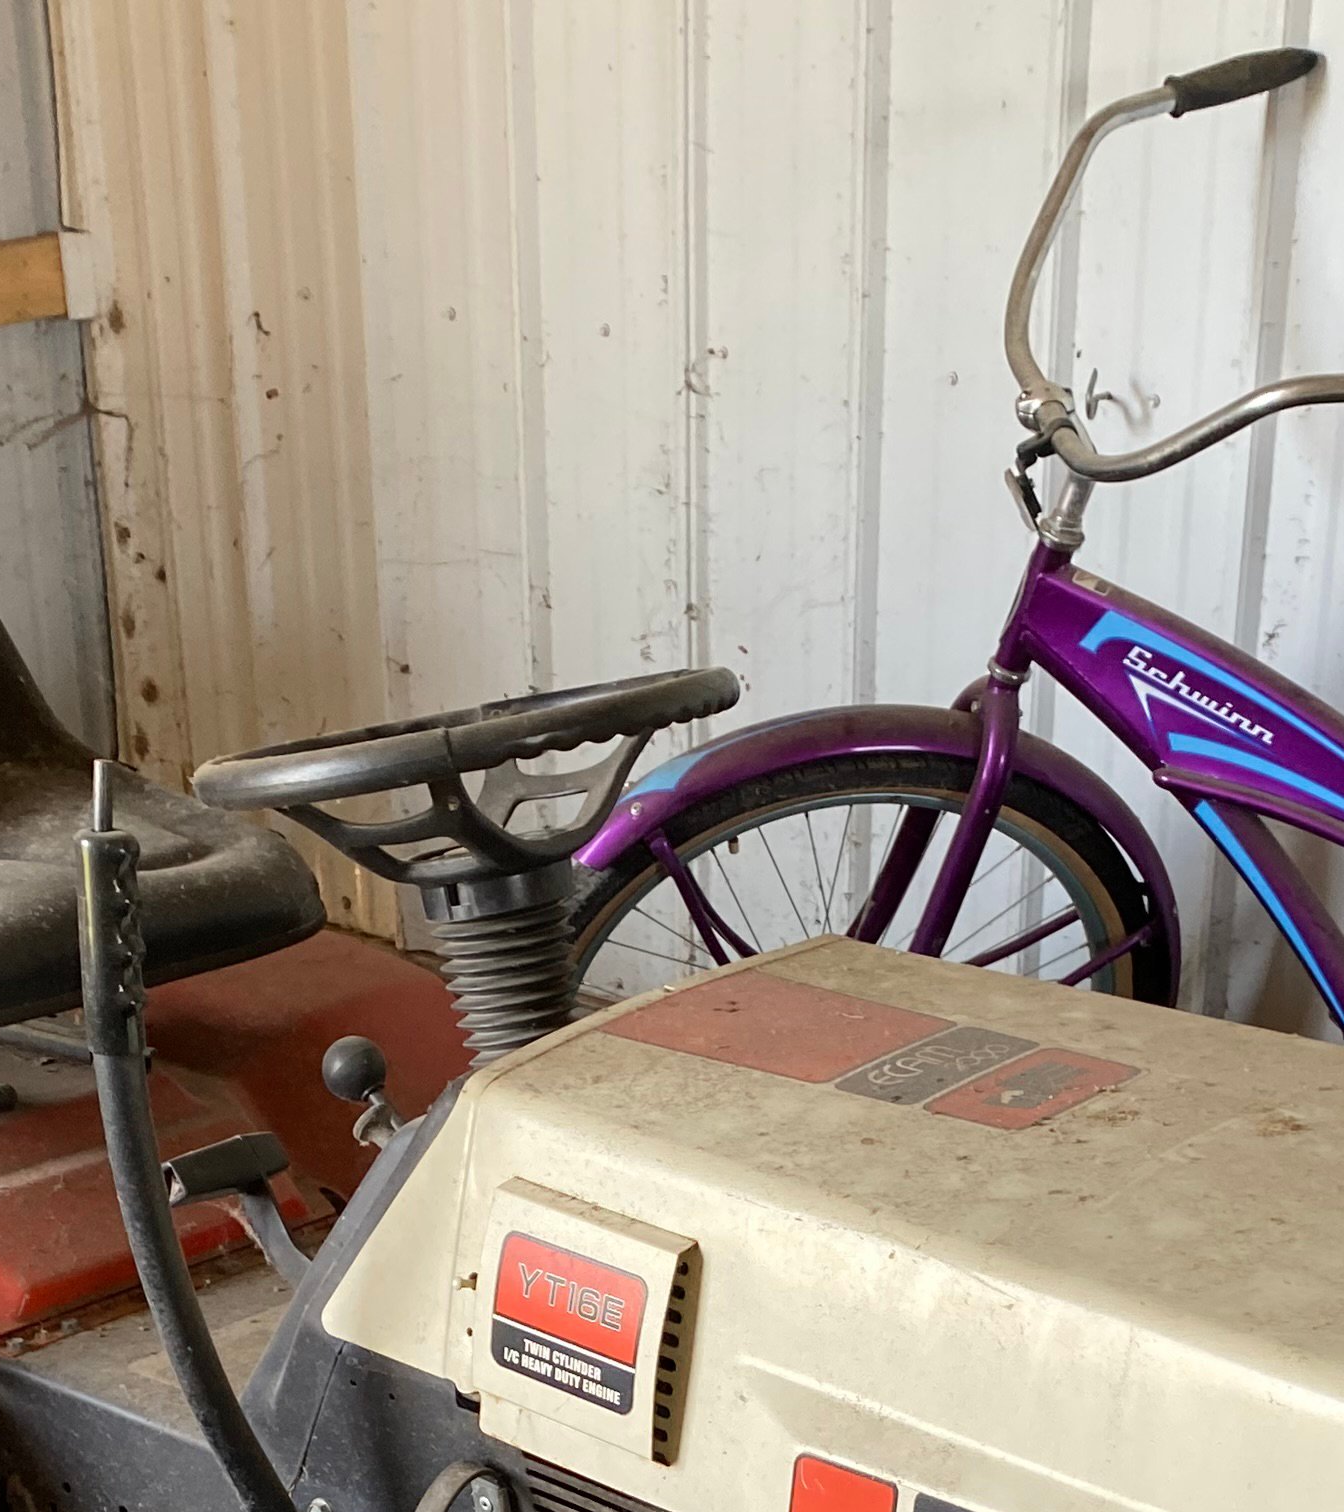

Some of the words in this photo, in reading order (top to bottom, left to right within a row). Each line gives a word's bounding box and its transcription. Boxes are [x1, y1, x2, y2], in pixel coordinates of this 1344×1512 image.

[1122, 644, 1276, 745] Schwinn
[519, 1263, 625, 1331] YT16E
[503, 1346, 520, 1364] I/C
[521, 1351, 553, 1377] HEAVY
[554, 1363, 581, 1388] DUTY
[582, 1377, 622, 1406] ENGINE
[523, 1338, 551, 1364] TWIN
[552, 1347, 602, 1382] CYLINDER
